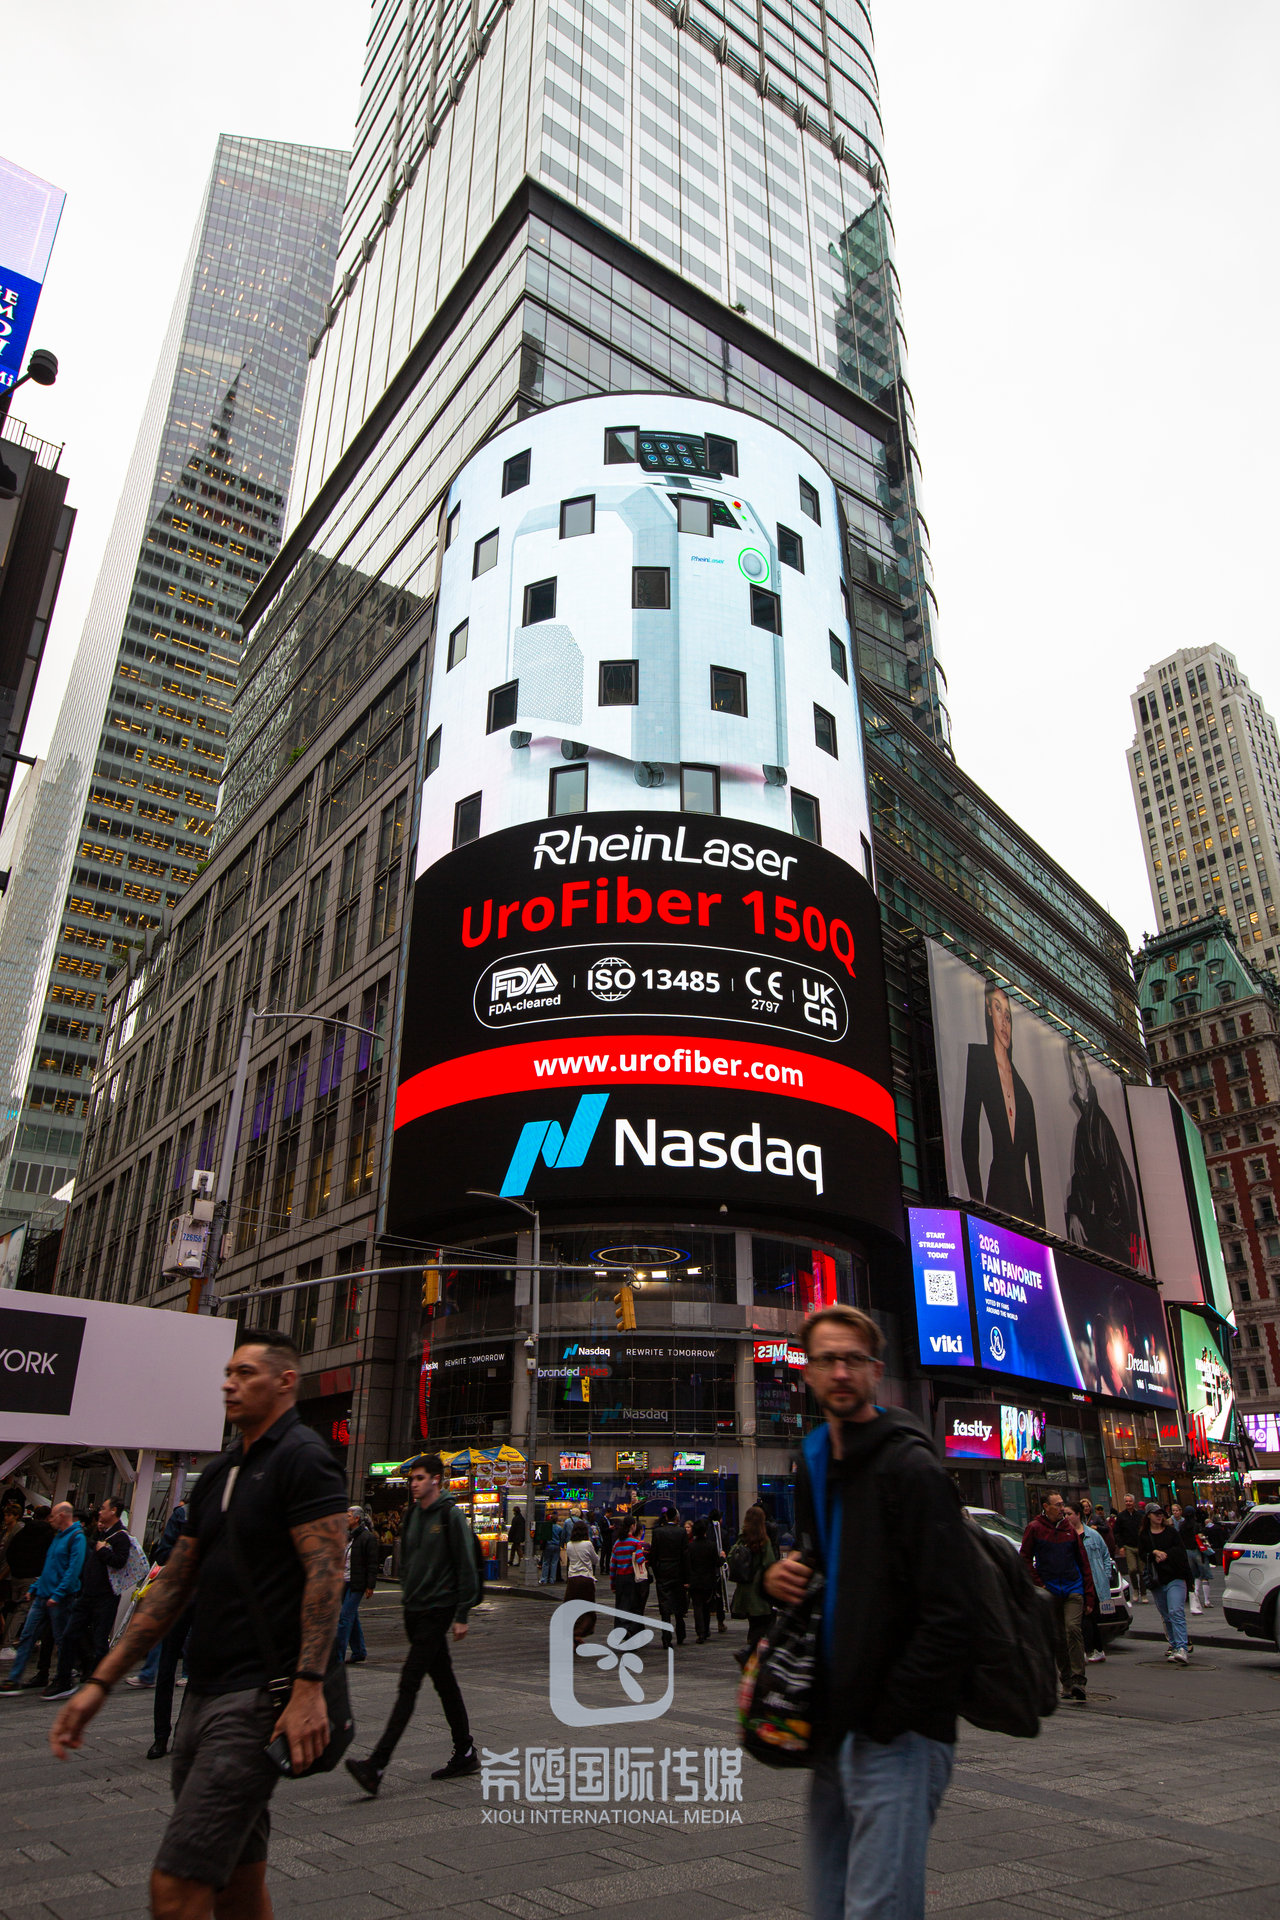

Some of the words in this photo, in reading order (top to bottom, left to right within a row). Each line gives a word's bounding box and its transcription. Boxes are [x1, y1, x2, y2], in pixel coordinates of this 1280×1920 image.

[533, 825, 798, 881] RheinLaser
[461, 876, 723, 948] UroFiber
[742, 890, 857, 979] 150Q
[491, 962, 559, 1002] FDA
[587, 968, 637, 991] ISO
[641, 968, 721, 994] 13485
[802, 978, 835, 1008] UK
[488, 995, 561, 1017] FDA-cleared
[751, 998, 780, 1014] 2797
[804, 1003, 838, 1031] CA
[533, 1048, 805, 1088] www.urofiber.com
[614, 1118, 825, 1196] Nasdaq
[918, 1241, 956, 1250] STREAMING
[927, 1251, 949, 1259] TODAY
[979, 1233, 1000, 1255] 2026
[980, 1252, 1000, 1277] FAN
[1001, 1259, 1043, 1290] FAVORITE
[983, 1273, 1028, 1304] K-DRAMA
[445, 1357, 466, 1367] REWRITE
[469, 1353, 505, 1364] TOMORROW
[579, 1346, 611, 1357] Nasdaq
[626, 1348, 664, 1356] REWRITE
[668, 1348, 716, 1358] TOMORROW
[1125, 1353, 1150, 1373] Dream
[623, 1407, 669, 1422] Nasdaq
